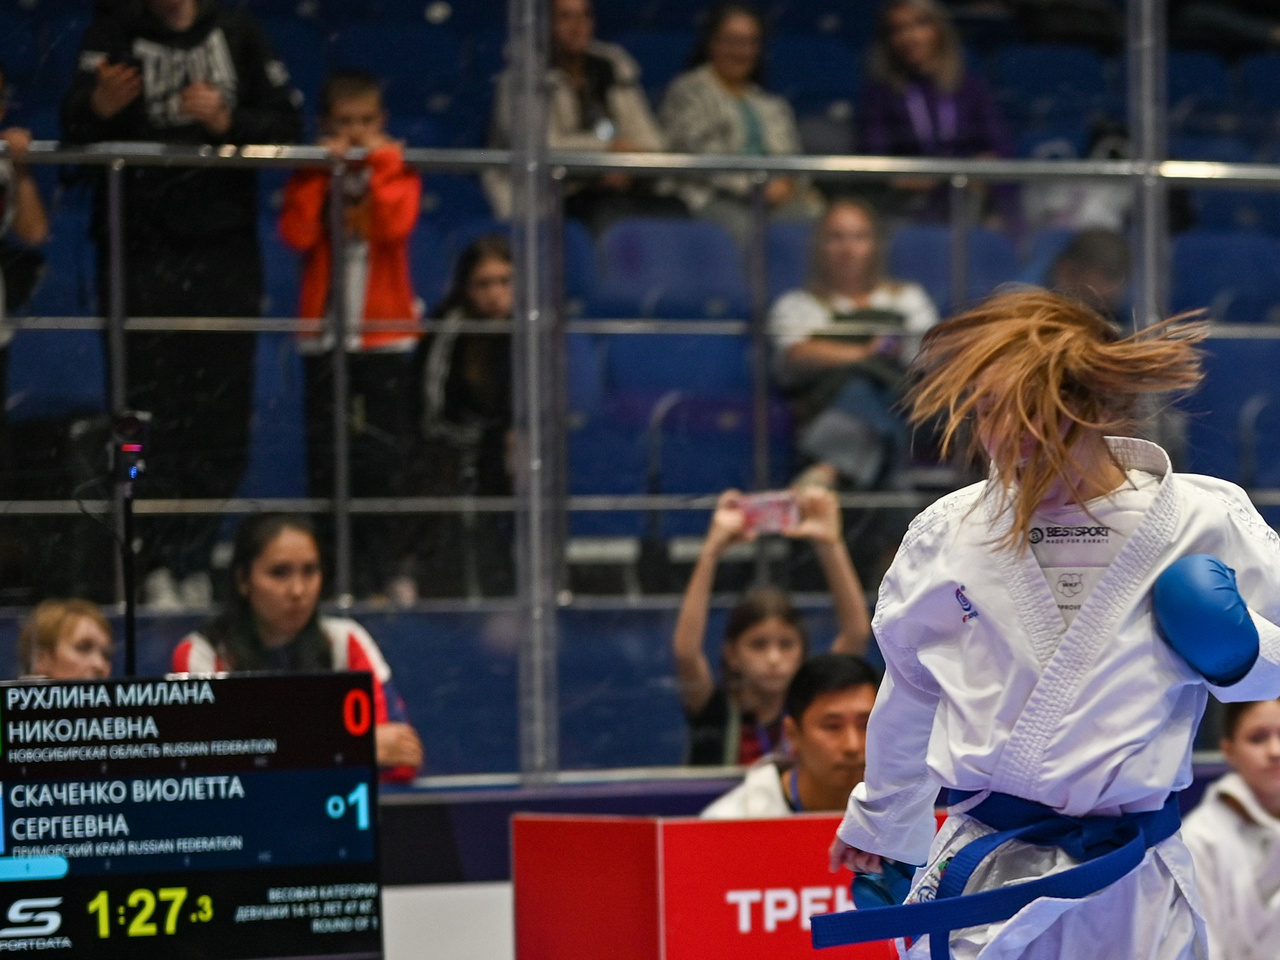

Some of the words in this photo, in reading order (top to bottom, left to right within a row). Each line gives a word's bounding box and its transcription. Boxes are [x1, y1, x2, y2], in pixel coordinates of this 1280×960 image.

[7, 684, 112, 711] РУХЛИНА
[116, 681, 216, 707] МИЛАНА
[343, 688, 371, 736] 0
[8, 716, 160, 743] НИКОЛАЕВНА
[162, 741, 208, 758] RUSSIAN
[10, 780, 127, 808] СКАЧЕНКО
[132, 776, 245, 803] ВИОЛЕТТА
[11, 813, 130, 841] СЕРГЕЕВНА
[127, 838, 174, 855] RUSSIAN
